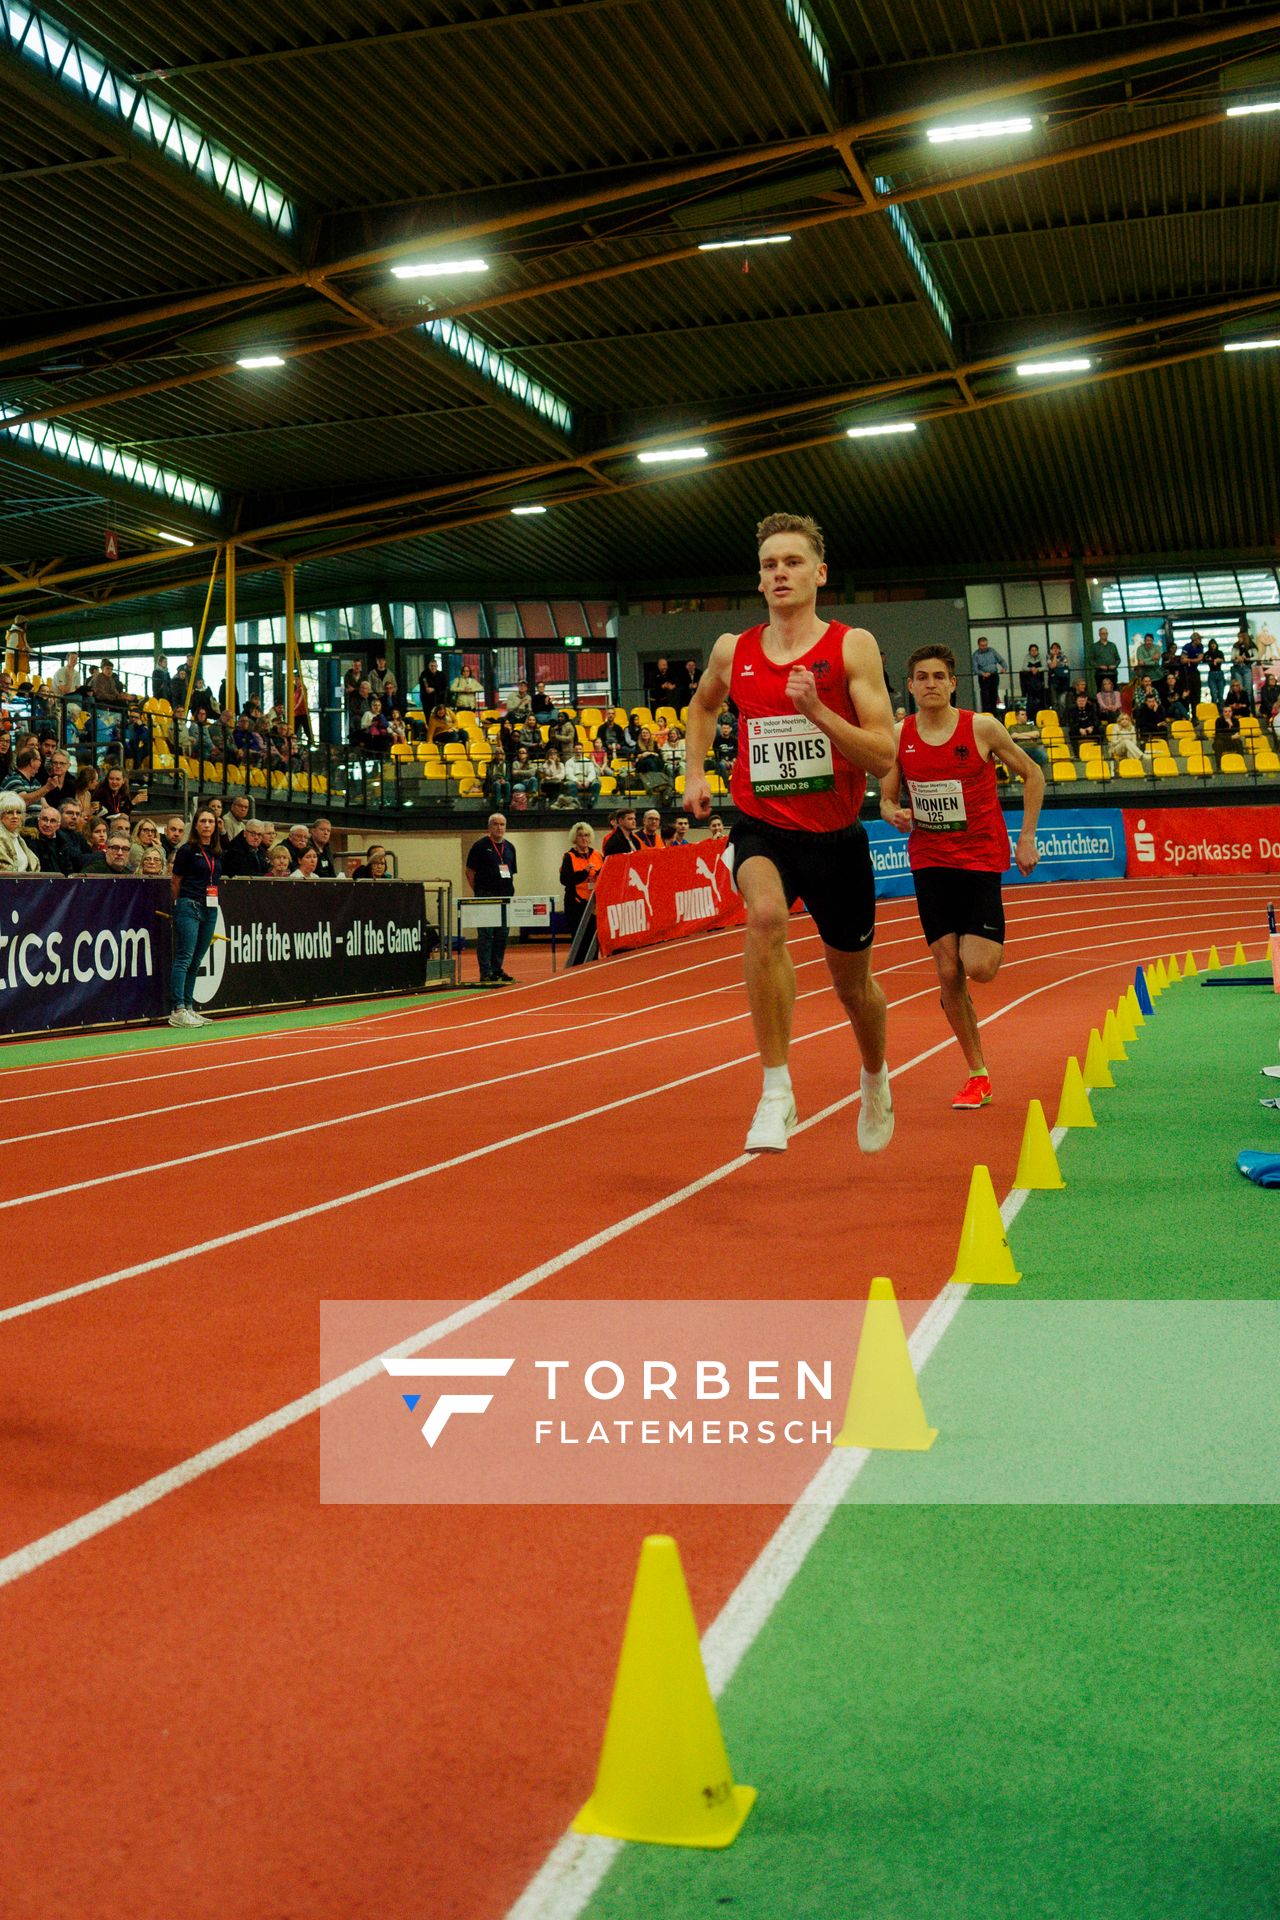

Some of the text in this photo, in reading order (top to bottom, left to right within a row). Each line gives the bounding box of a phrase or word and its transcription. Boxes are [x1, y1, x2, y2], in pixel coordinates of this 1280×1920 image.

[107, 536, 115, 555] A
[763, 717, 807, 727] Indoor Meeting
[763, 726, 793, 734] Dortmund
[753, 744, 770, 764] DE
[774, 739, 826, 762] VRIES
[779, 763, 797, 779] 35
[755, 781, 809, 792] DORTMUND 26
[914, 796, 958, 812] MONIEN
[927, 811, 944, 822] 125
[1164, 838, 1252, 866] Sparkasse
[675, 886, 716, 923] PUMA
[607, 899, 647, 939] PUMA
[230, 922, 263, 964] Half
[265, 922, 291, 961] the
[294, 921, 331, 960] world
[346, 920, 361, 956] all
[364, 919, 384, 955] the
[387, 919, 422, 954] Game!
